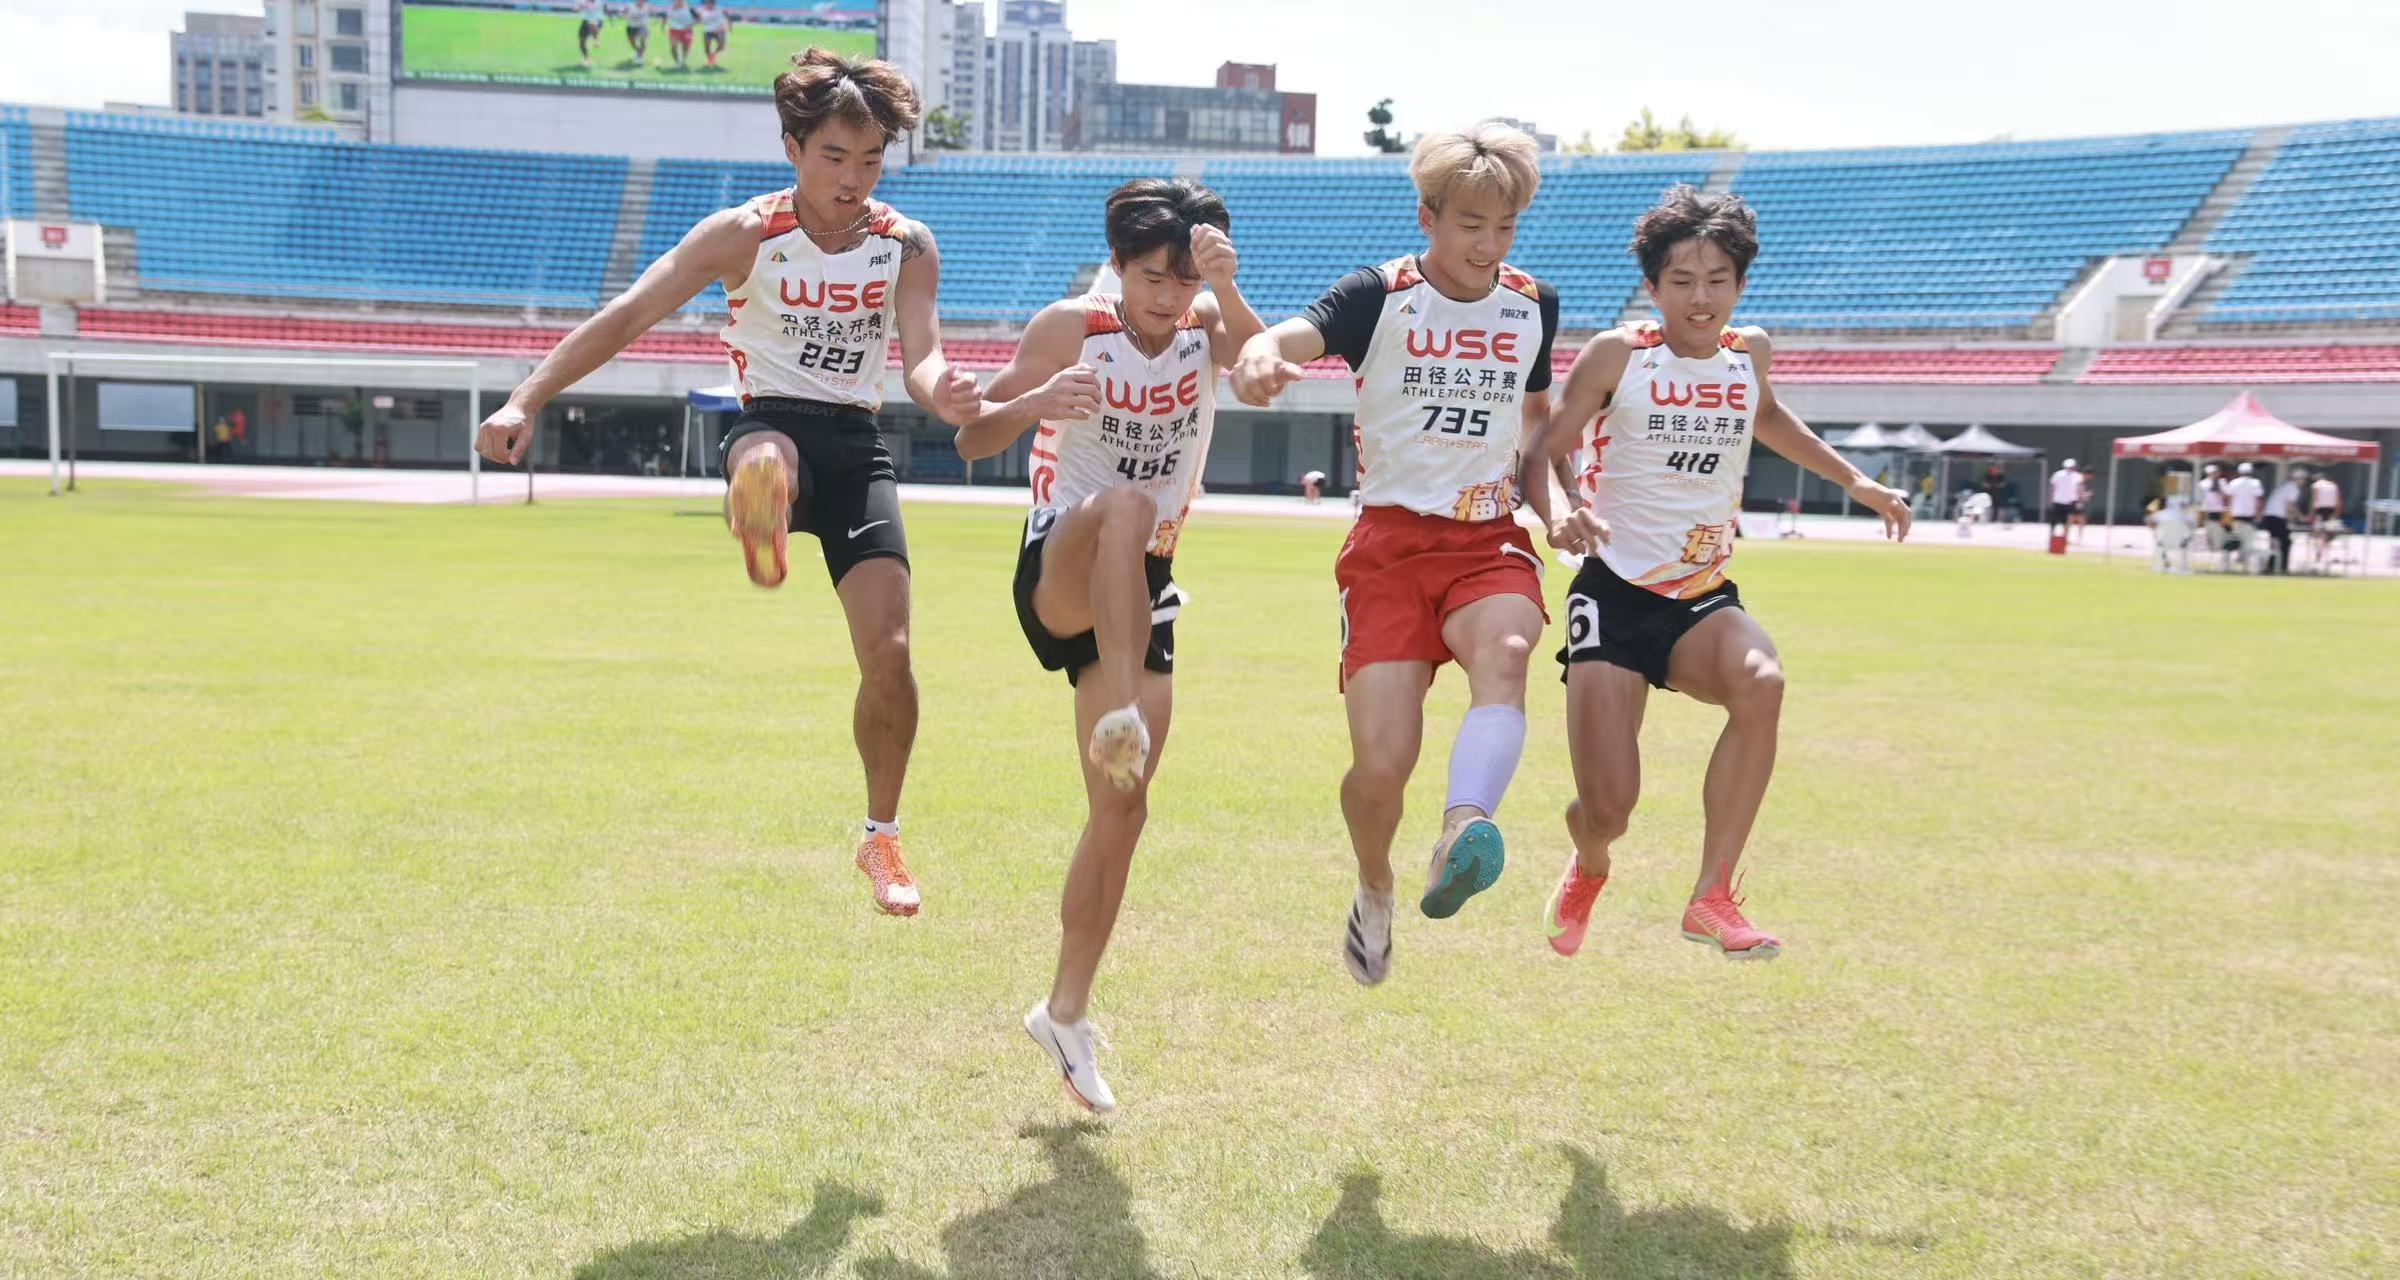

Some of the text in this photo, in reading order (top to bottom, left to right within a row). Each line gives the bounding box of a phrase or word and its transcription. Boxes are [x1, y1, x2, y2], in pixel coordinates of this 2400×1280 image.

[780, 277, 888, 313] WSE
[780, 313, 882, 335] 田径公开赛
[853, 330, 882, 342] OPEN
[799, 342, 865, 374] 223
[1406, 327, 1519, 363] WSE
[1106, 369, 1199, 416] WSE
[1403, 366, 1518, 390] 田径公开赛
[1402, 386, 1515, 403] ATHLETICS OPEN
[1650, 379, 1748, 411] WSE
[1422, 405, 1491, 437] 735
[1648, 414, 1747, 435] 田径公开赛
[1646, 433, 1713, 445] ATHLETICS
[1117, 449, 1181, 480] 456
[1666, 451, 1720, 474] 418
[1568, 597, 1591, 646] 6
